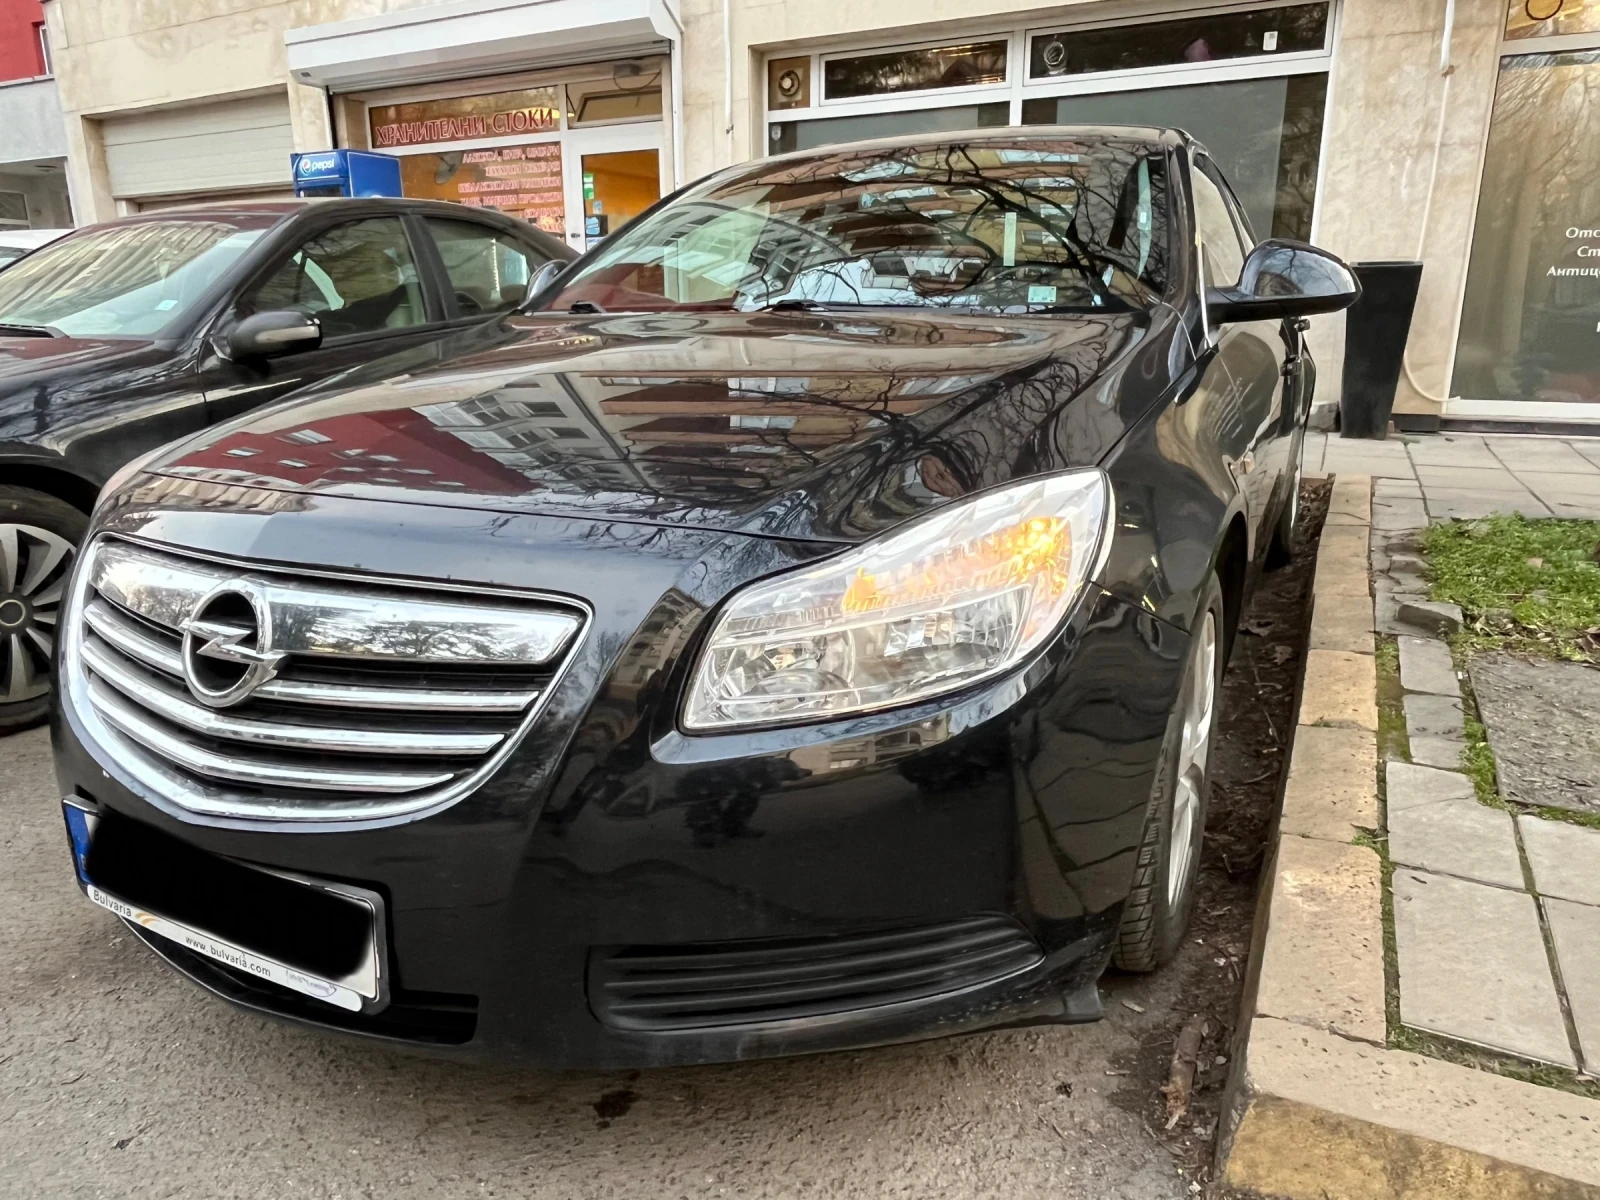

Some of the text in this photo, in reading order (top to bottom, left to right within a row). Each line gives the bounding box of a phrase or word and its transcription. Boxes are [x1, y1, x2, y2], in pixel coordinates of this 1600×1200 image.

[377, 107, 554, 145] ХРАНИТЕЛНИ СТОКИ
[311, 158, 335, 172] pepsi
[1565, 227, 1600, 238] Отс
[1546, 265, 1600, 279] Антиц
[93, 889, 132, 917] Bulvaria
